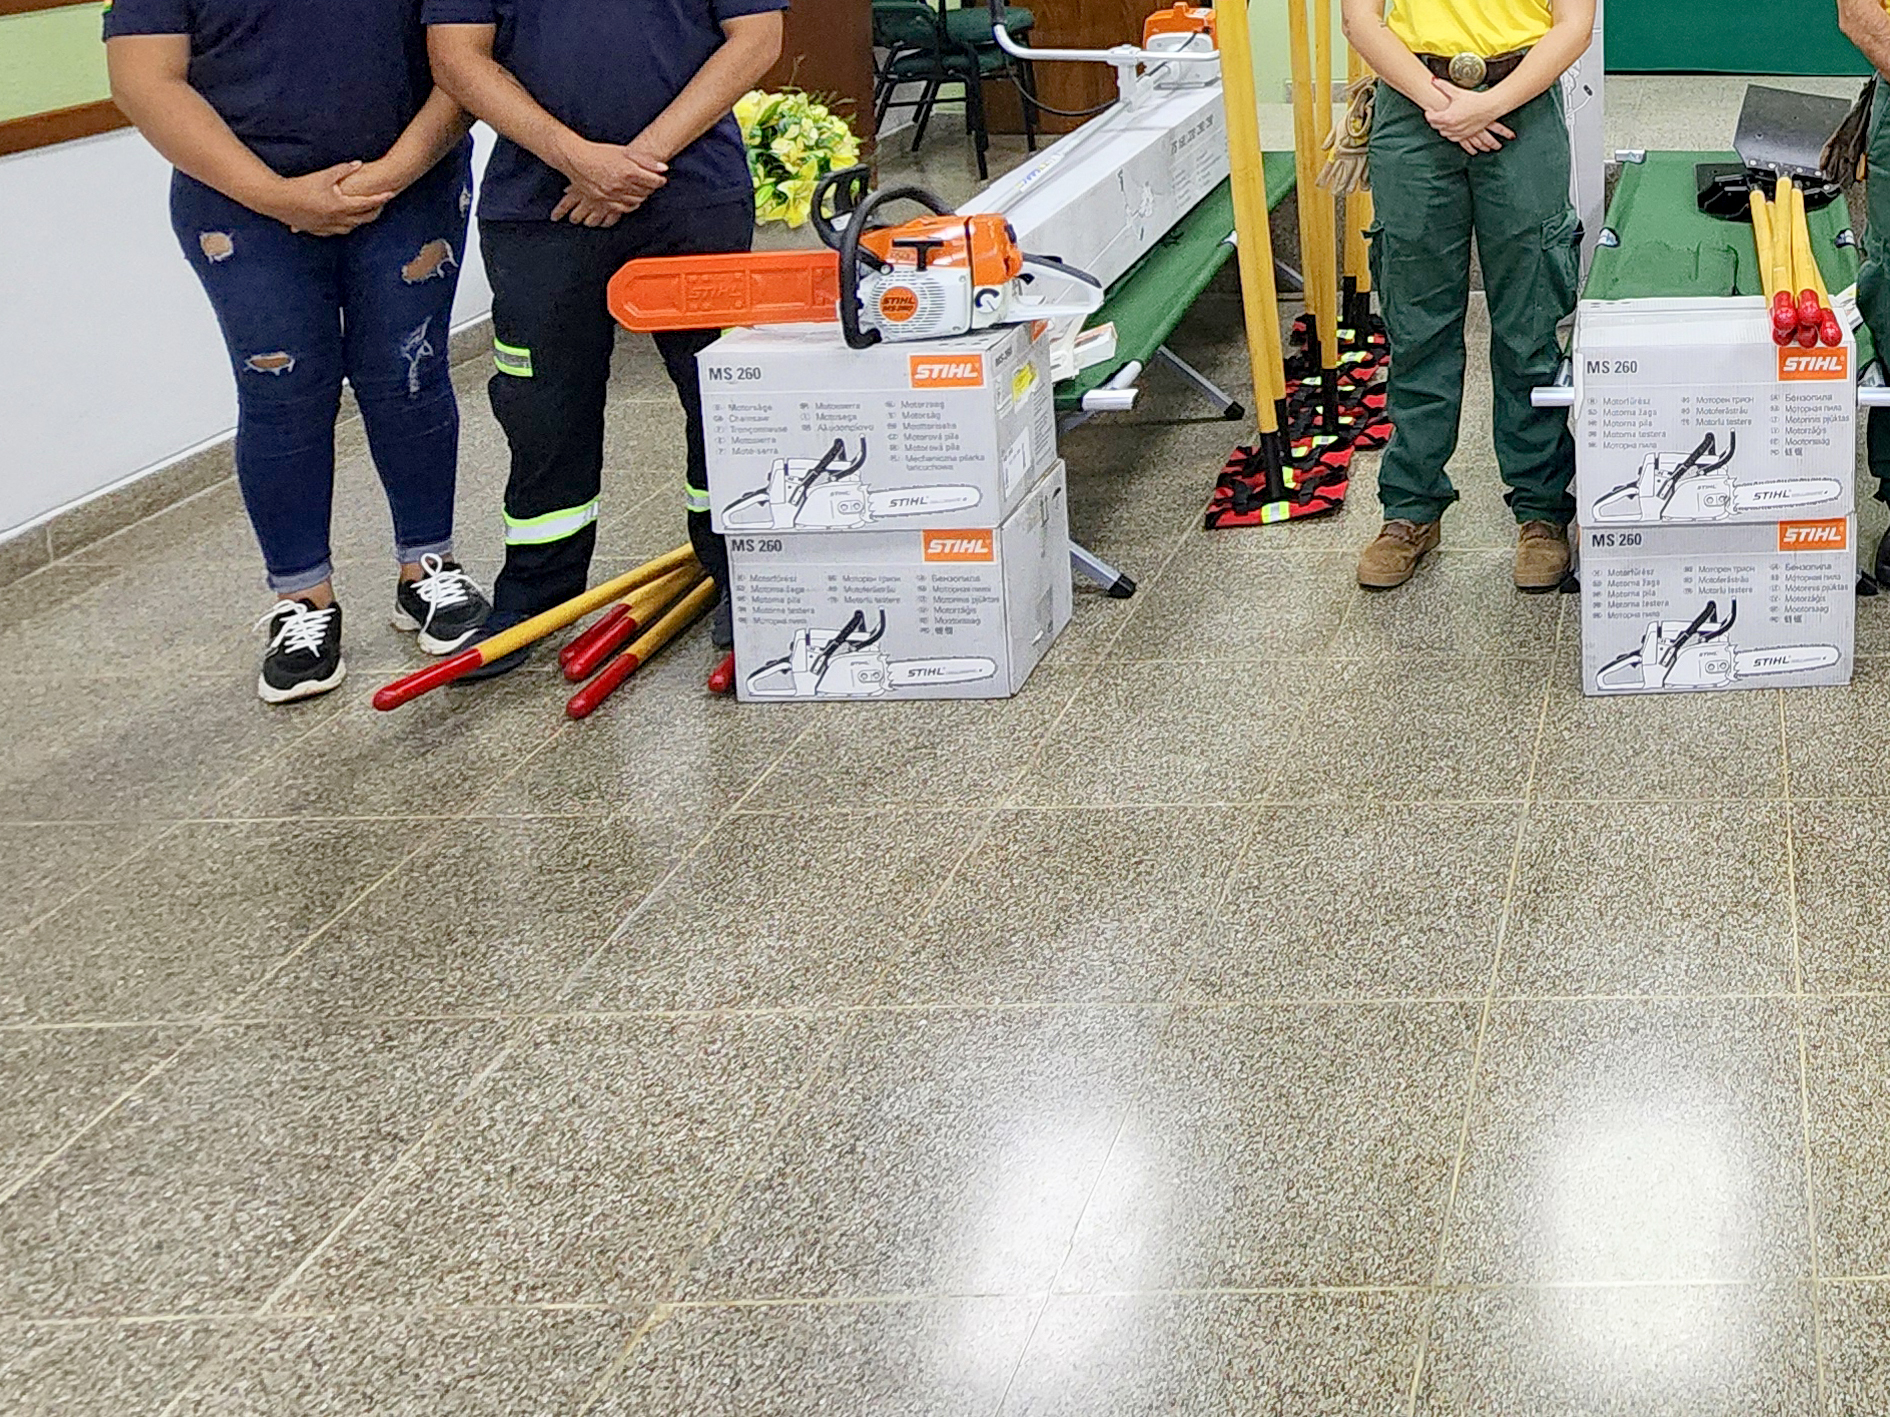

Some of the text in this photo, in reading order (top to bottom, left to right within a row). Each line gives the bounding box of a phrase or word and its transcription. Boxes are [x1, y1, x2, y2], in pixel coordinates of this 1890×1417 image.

[882, 296, 915, 304] STIHL
[1587, 361, 1638, 374] MS 260
[1783, 356, 1842, 372] STIHL
[709, 367, 761, 381] MS 260
[915, 363, 978, 379] STIHL
[889, 497, 928, 507] STIHL
[1753, 490, 1790, 501] STIHL
[1592, 533, 1643, 547] MS 260
[1783, 526, 1842, 543] STIHL
[732, 539, 783, 552] MS 260
[928, 539, 988, 554] STIHL
[1753, 656, 1790, 668] STIHL
[908, 668, 944, 677] STIHL
